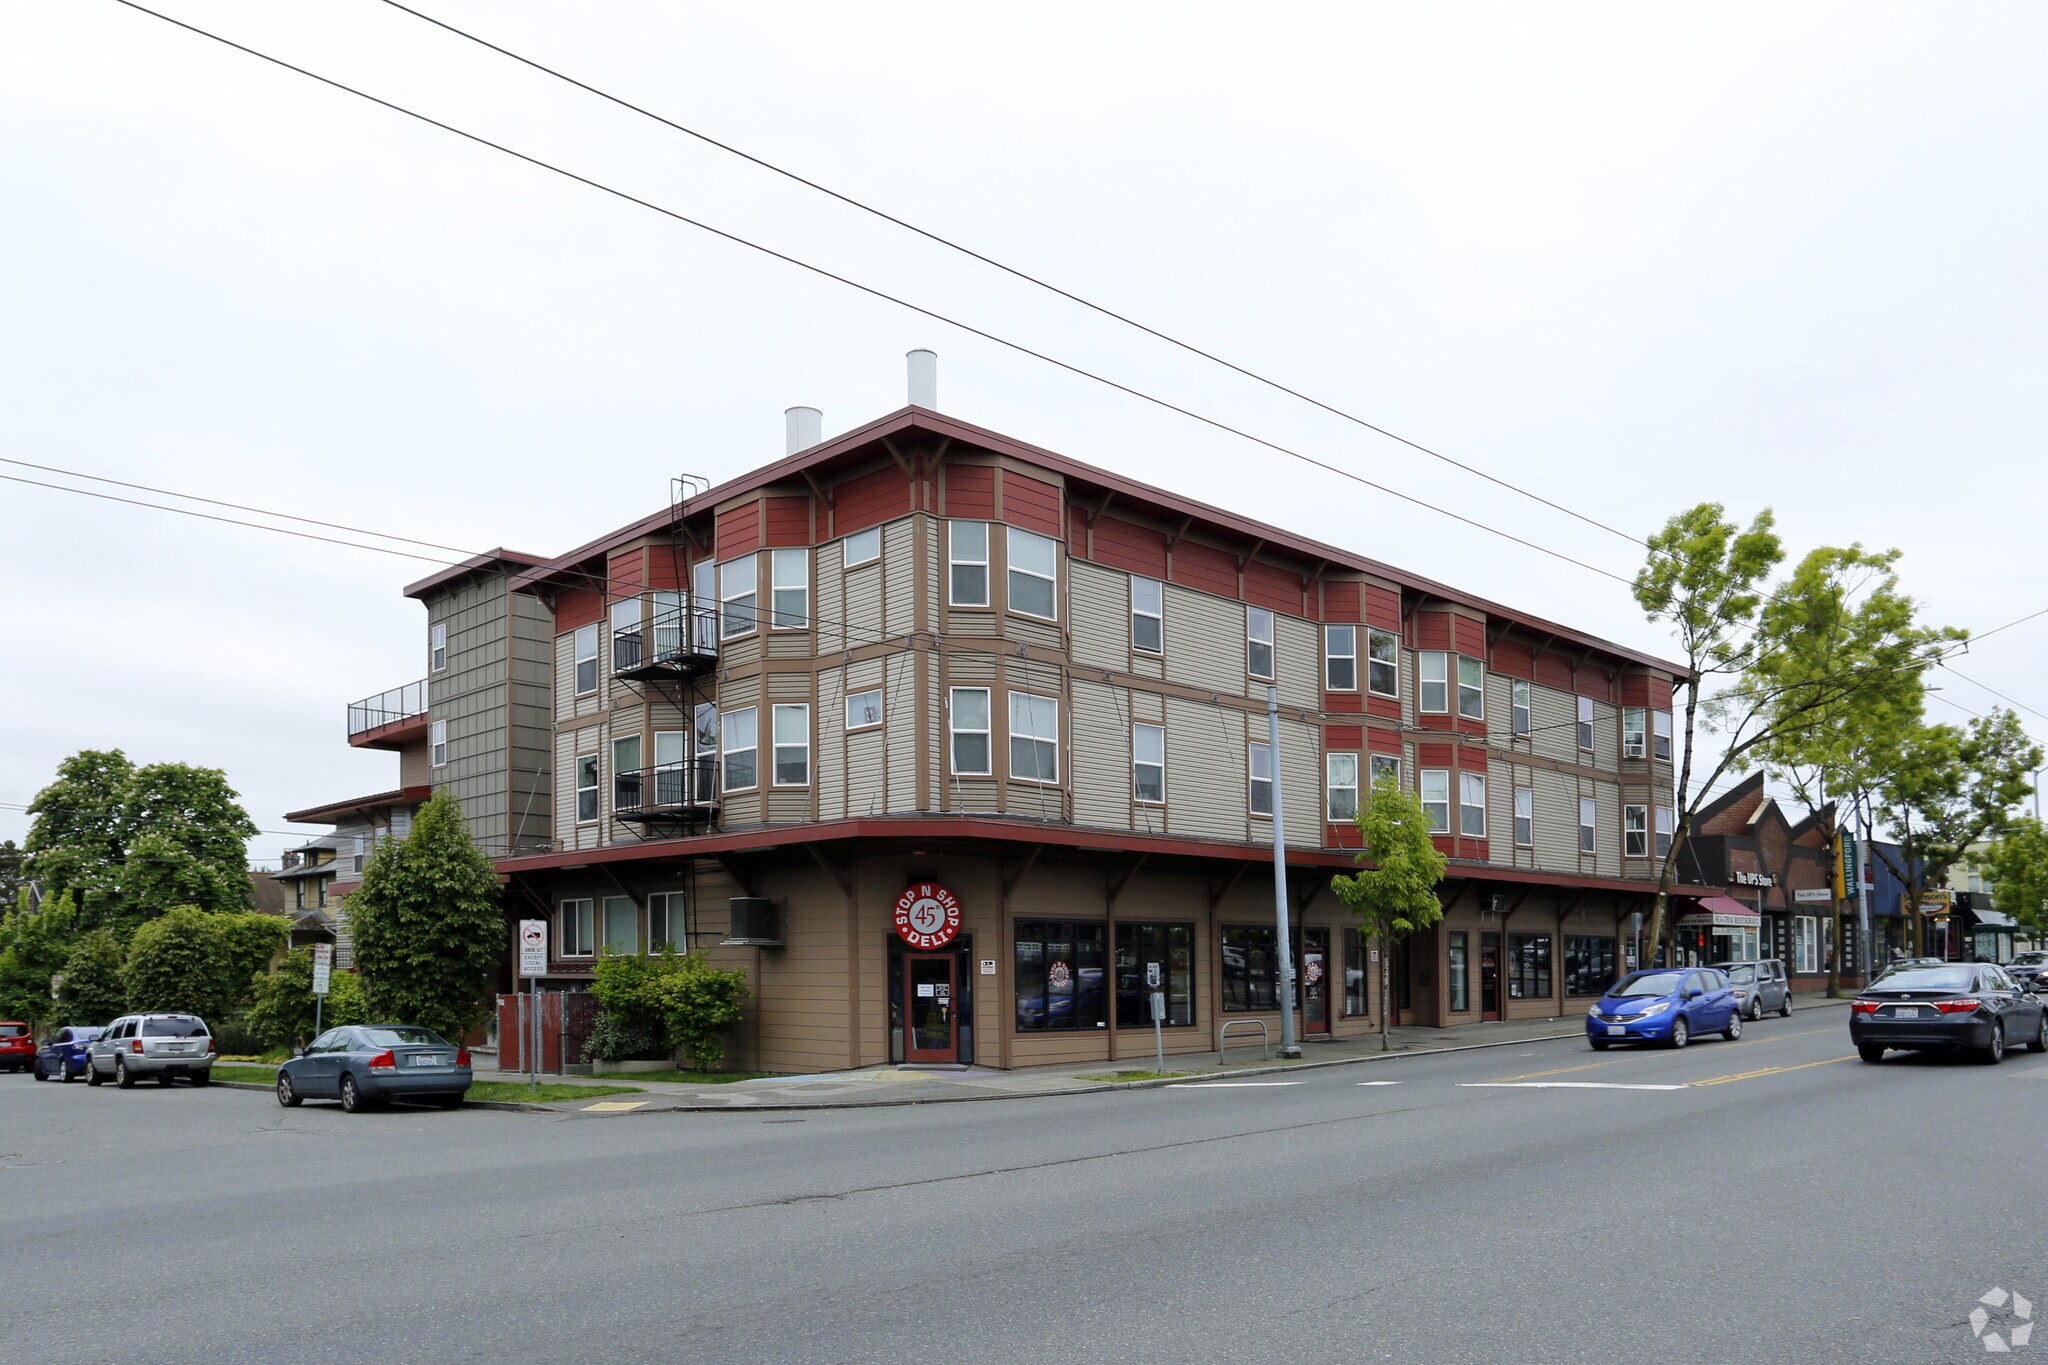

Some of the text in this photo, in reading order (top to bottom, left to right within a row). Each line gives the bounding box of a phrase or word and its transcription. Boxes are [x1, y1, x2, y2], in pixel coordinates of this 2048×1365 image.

[1736, 872, 1773, 887] The UPS Store
[1844, 836, 1854, 895] WALLINGFORD
[895, 885, 960, 927] STOP N SHOP
[907, 931, 949, 947] DELI
